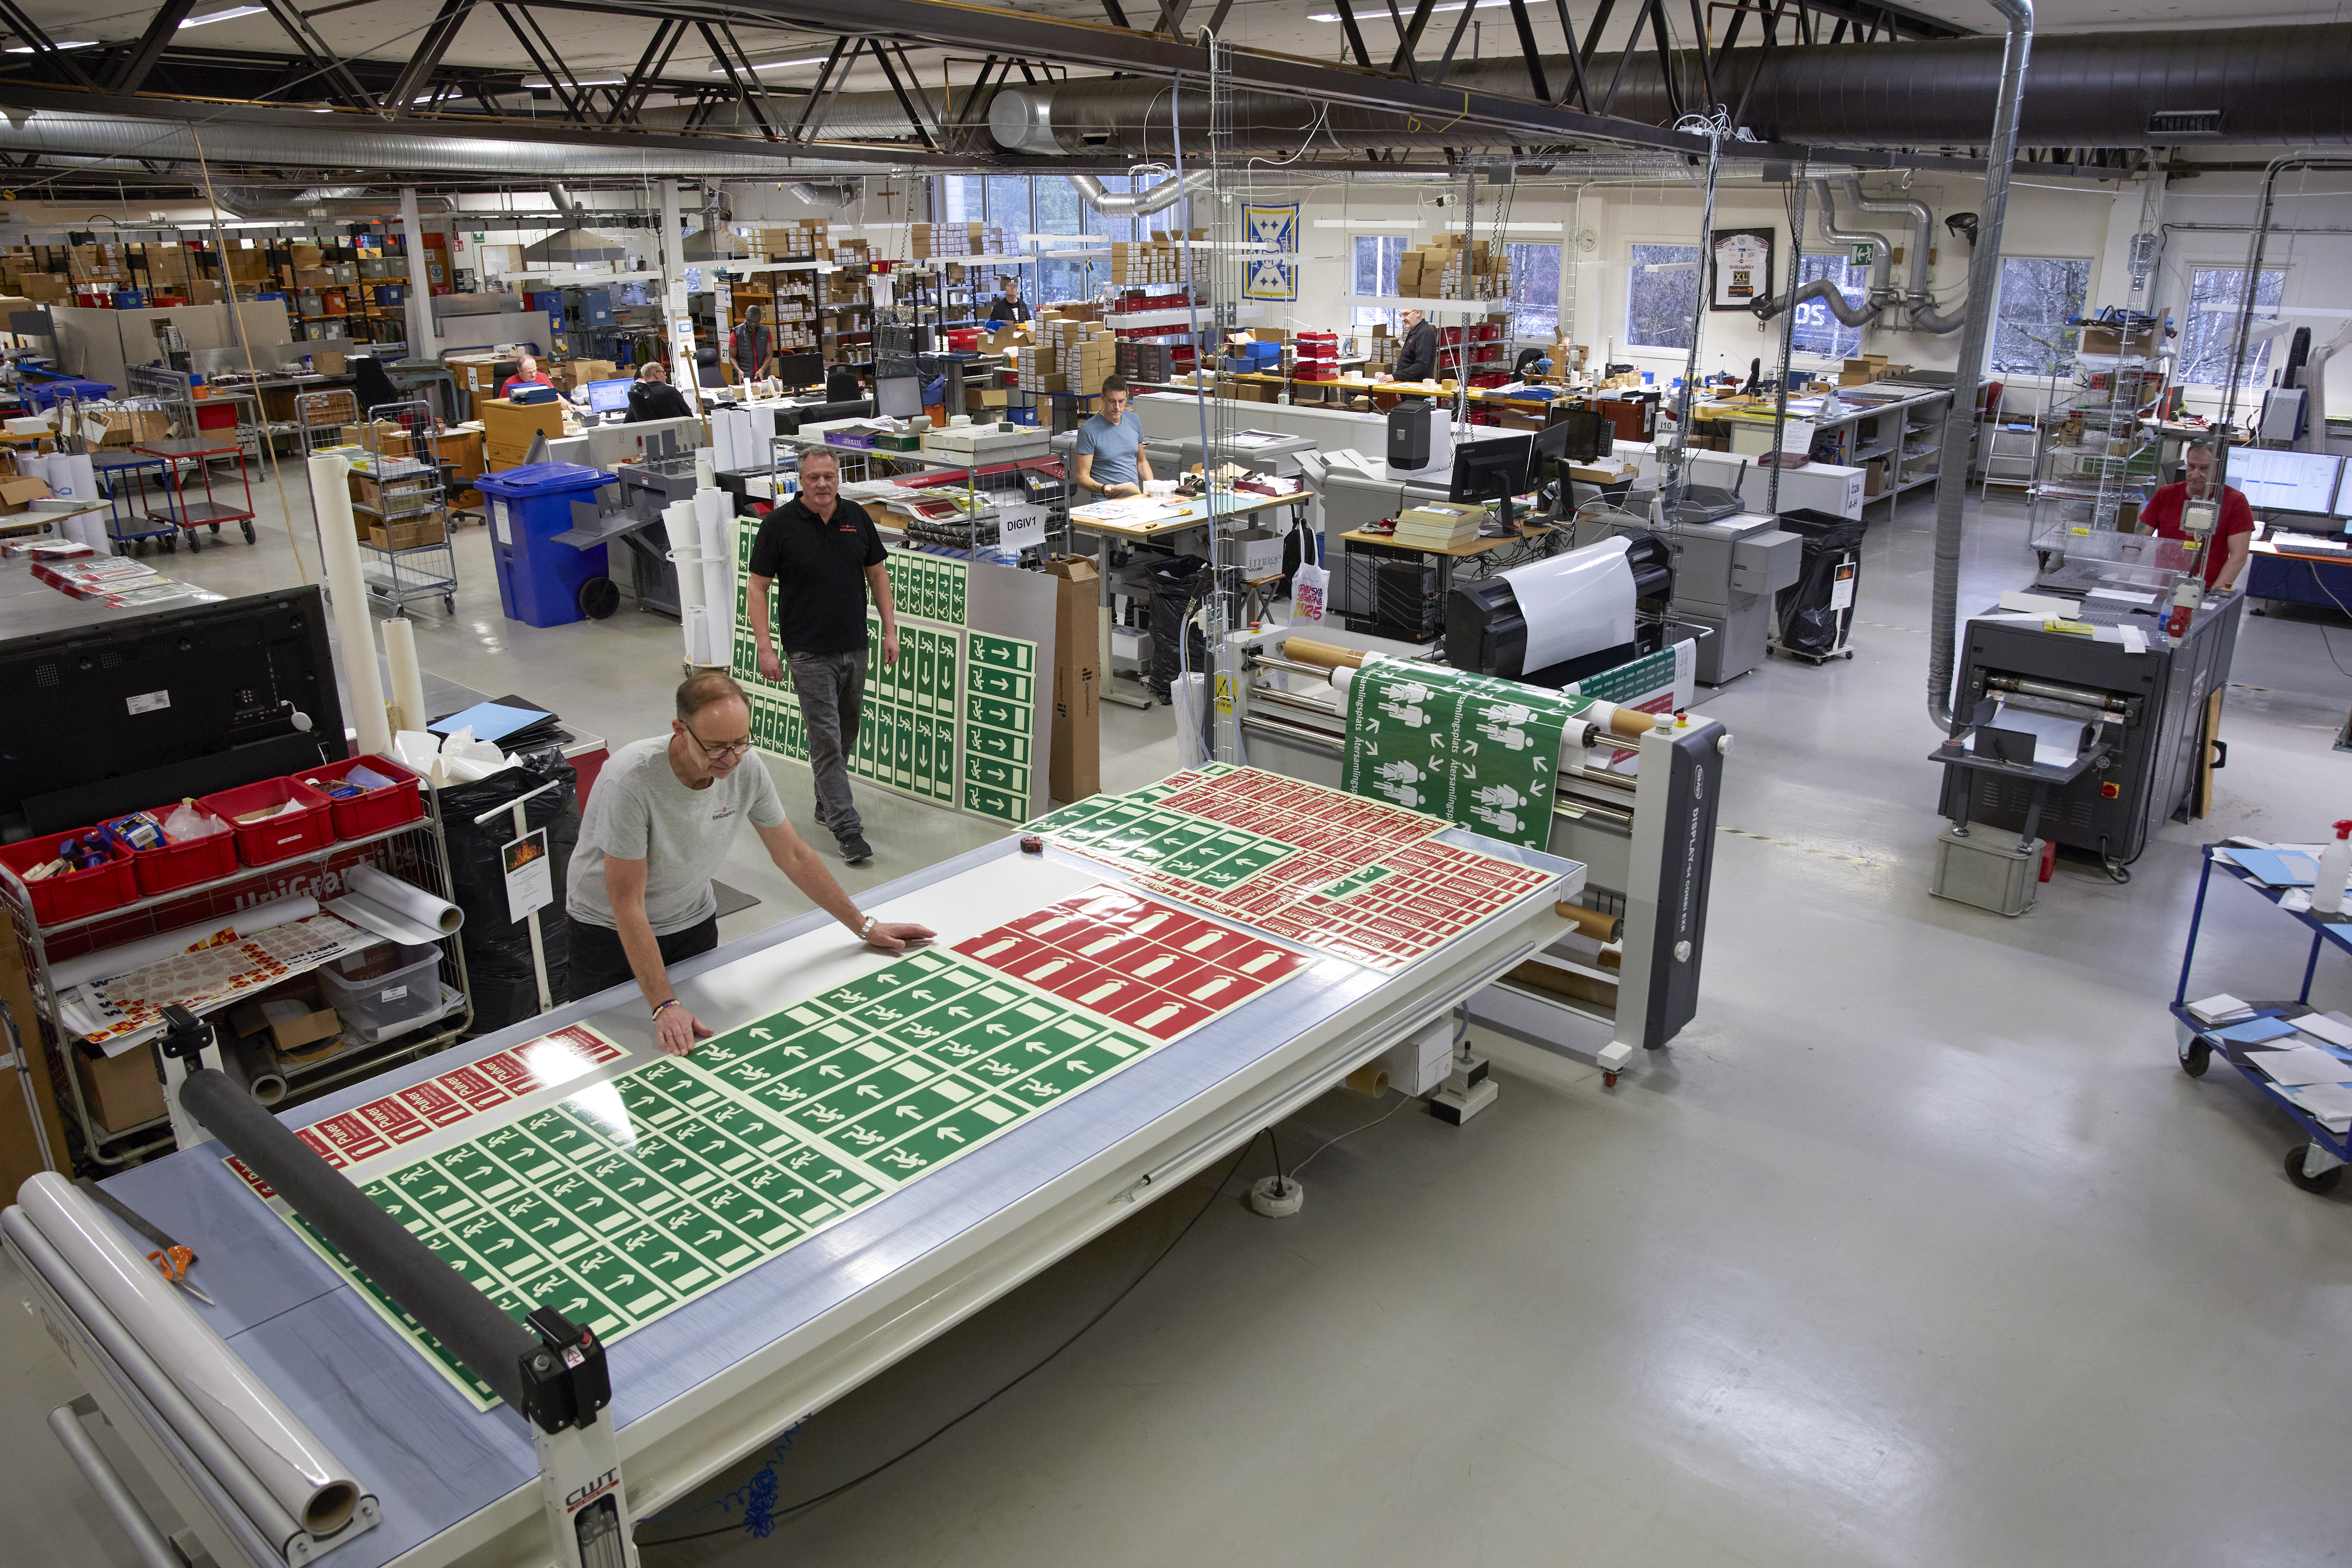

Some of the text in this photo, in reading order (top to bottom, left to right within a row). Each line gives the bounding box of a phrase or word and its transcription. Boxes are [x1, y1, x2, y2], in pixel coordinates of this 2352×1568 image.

[470, 376, 476, 384] 27
[842, 436, 862, 447] image
[1851, 484, 1859, 494] Ö28
[1848, 498, 1858, 510] A-H
[1007, 516, 1036, 531] DIGIV1
[1248, 554, 1281, 570] image
[1293, 602, 1322, 620] 2025
[1350, 736, 1366, 794] Återsamlingsp
[1217, 776, 1245, 788] Kolsyra
[1238, 782, 1267, 794] Kolsyra
[1260, 789, 1288, 801] Kolsyra
[1445, 758, 1461, 822] Återsamlingspl
[1170, 795, 1199, 807] Kolsyra
[1192, 801, 1221, 813] Kolsyra
[1282, 796, 1311, 807] Kolsyra
[1213, 807, 1243, 819] Kolsyra
[1305, 802, 1333, 814] Kolsyra
[712, 810, 735, 820] UniGraphics
[1236, 814, 1266, 826] Kolsyra
[1328, 809, 1355, 821] Kolsyra
[1352, 815, 1380, 828] Kolsyra
[1258, 821, 1288, 834] Kolsyra
[1376, 822, 1404, 835] Kolsyra
[1282, 828, 1312, 841] Kolsyra
[1400, 829, 1429, 843] Kolsyra
[1307, 835, 1336, 849] Kolsyra
[1330, 843, 1360, 856] Kolsyra
[1417, 844, 1448, 856] Skum
[1356, 850, 1385, 864] Kolsyra
[1399, 853, 1431, 865] Skum
[1282, 865, 1313, 879] Kolsyra
[1381, 862, 1414, 875] Skum
[1481, 862, 1515, 876] Skum
[1464, 872, 1498, 885] Skum
[1447, 882, 1480, 895] Skum
[1230, 889, 1263, 905] Kolsyra
[1429, 892, 1463, 906] Skum
[1198, 899, 1230, 913] Skum
[1256, 896, 1289, 914] Kolsyra
[1410, 902, 1444, 916] Skum
[1283, 911, 1316, 925] Skum
[1391, 912, 1426, 926] Skum
[1262, 921, 1295, 936] Skum
[1372, 923, 1406, 937] Skum
[1351, 933, 1386, 948] Skum
[383, 993, 406, 1001] INVENTERING
[482, 1062, 512, 1081] Pulver
[445, 1076, 474, 1096] Pulver
[405, 1091, 435, 1112] Pulver
[365, 1107, 395, 1128] Pulver
[324, 1123, 353, 1145] Pulver
[566, 1467, 617, 1506] CWT
